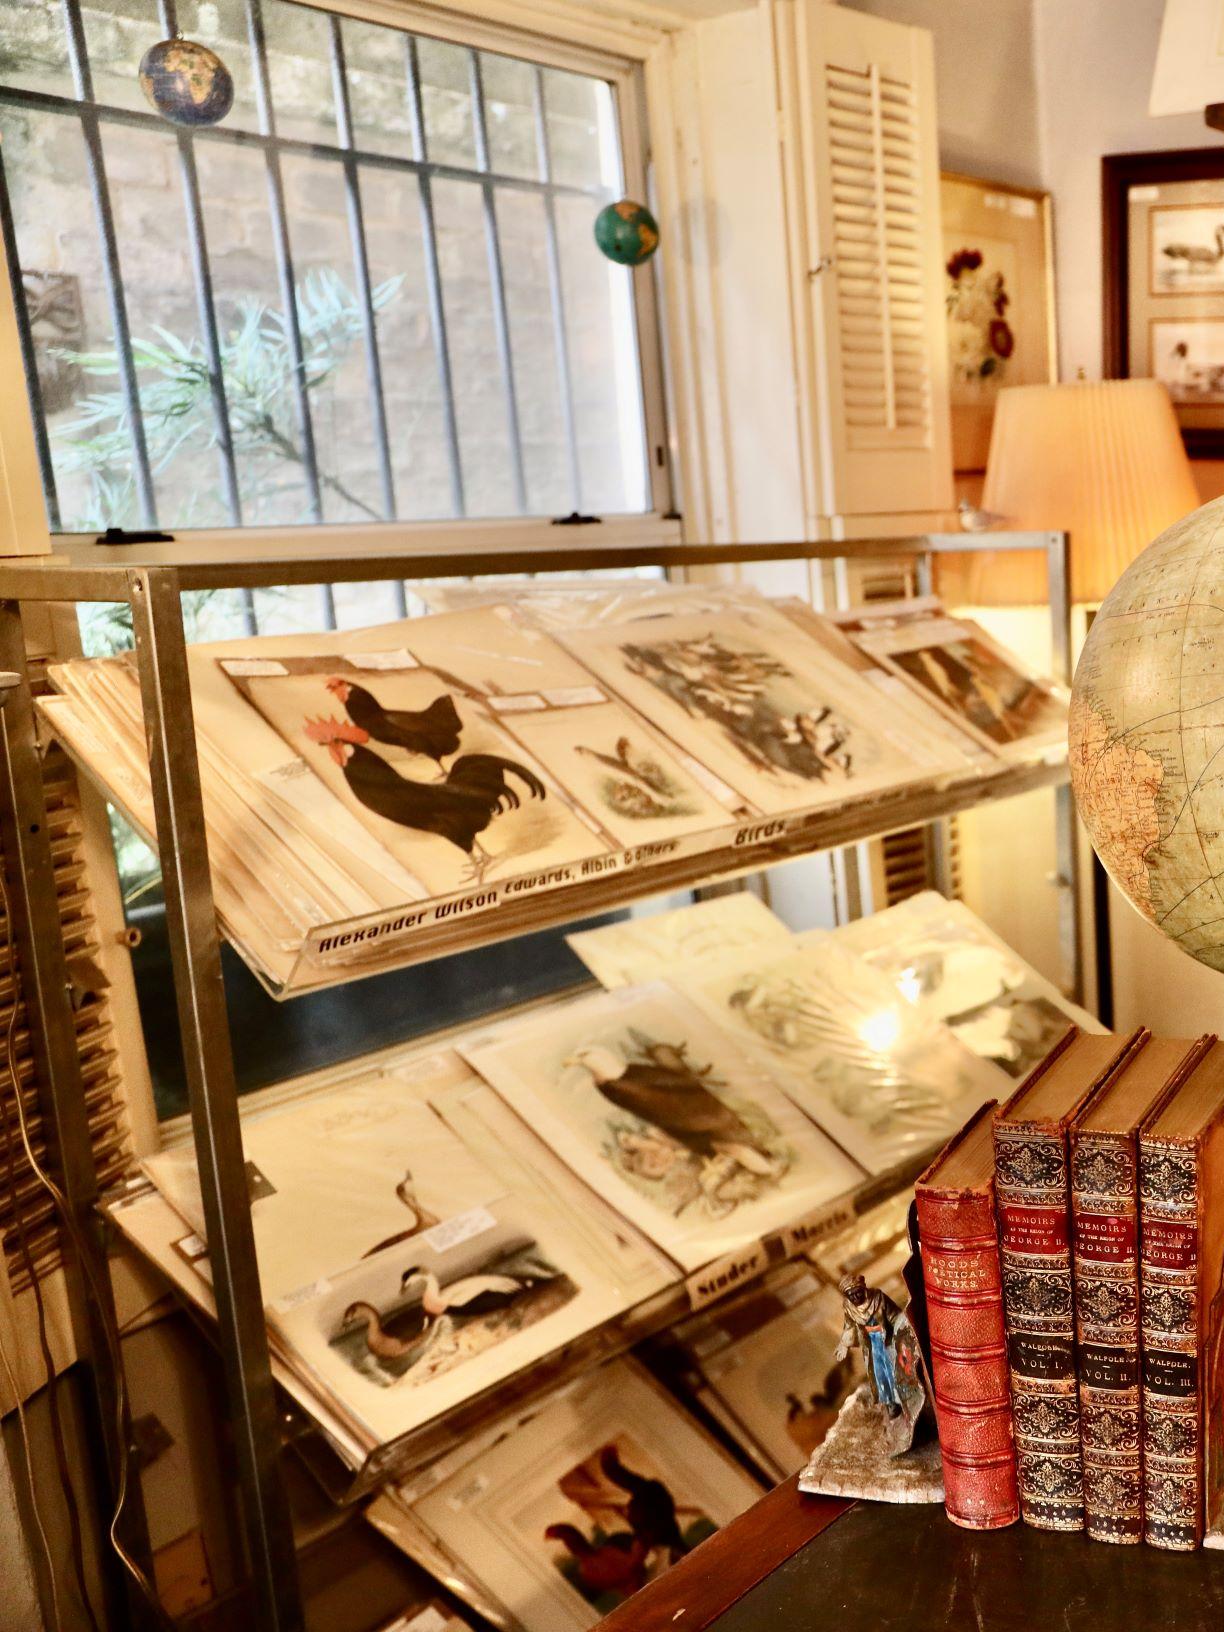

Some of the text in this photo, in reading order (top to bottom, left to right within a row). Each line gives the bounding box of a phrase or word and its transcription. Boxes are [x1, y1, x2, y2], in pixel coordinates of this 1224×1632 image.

[735, 818, 787, 846] Birds
[504, 868, 576, 894] Edwards,
[581, 855, 617, 876] Albin
[319, 890, 498, 953] Alexander Wilson
[1007, 1214, 1056, 1225] MEMOIRS
[1077, 1221, 1127, 1233] MEMOIRS
[1143, 1227, 1193, 1240] MEMOIRS
[1003, 1235, 1049, 1246] GEORGE
[1021, 1358, 1049, 1369] VOL.
[1085, 1369, 1132, 1382] VOL. II.
[1145, 1374, 1194, 1388] VOL. III.
